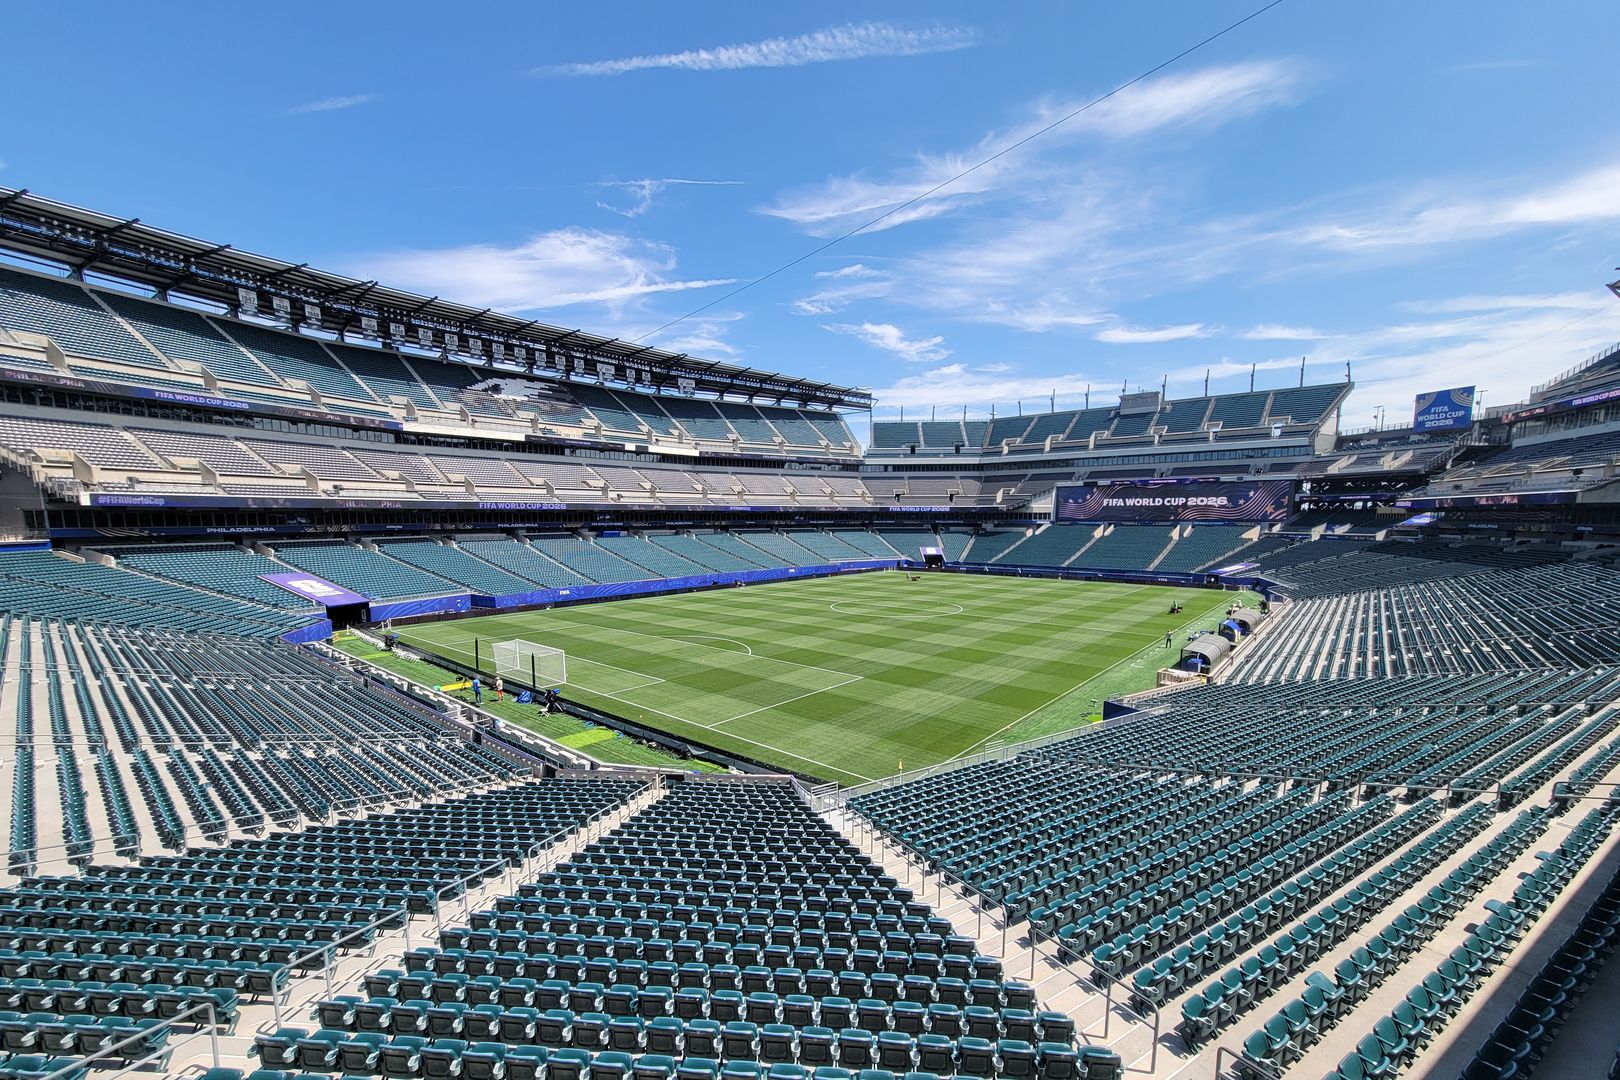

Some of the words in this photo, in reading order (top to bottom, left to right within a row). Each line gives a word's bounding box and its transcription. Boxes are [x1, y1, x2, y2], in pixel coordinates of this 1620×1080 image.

[155, 391, 175, 400] FIFA
[175, 394, 205, 404] WORLD
[222, 401, 250, 409] 2026
[1430, 405, 1449, 414] FIFA
[1417, 412, 1446, 422] WORLD
[1446, 410, 1465, 418] CUP
[1424, 418, 1454, 428] 2026
[98, 496, 165, 505] #FIFAWorldCup
[1103, 498, 1125, 507] FIFA
[1125, 497, 1161, 506] WORLD
[1163, 497, 1186, 506] CUP
[1187, 496, 1228, 506] 2026
